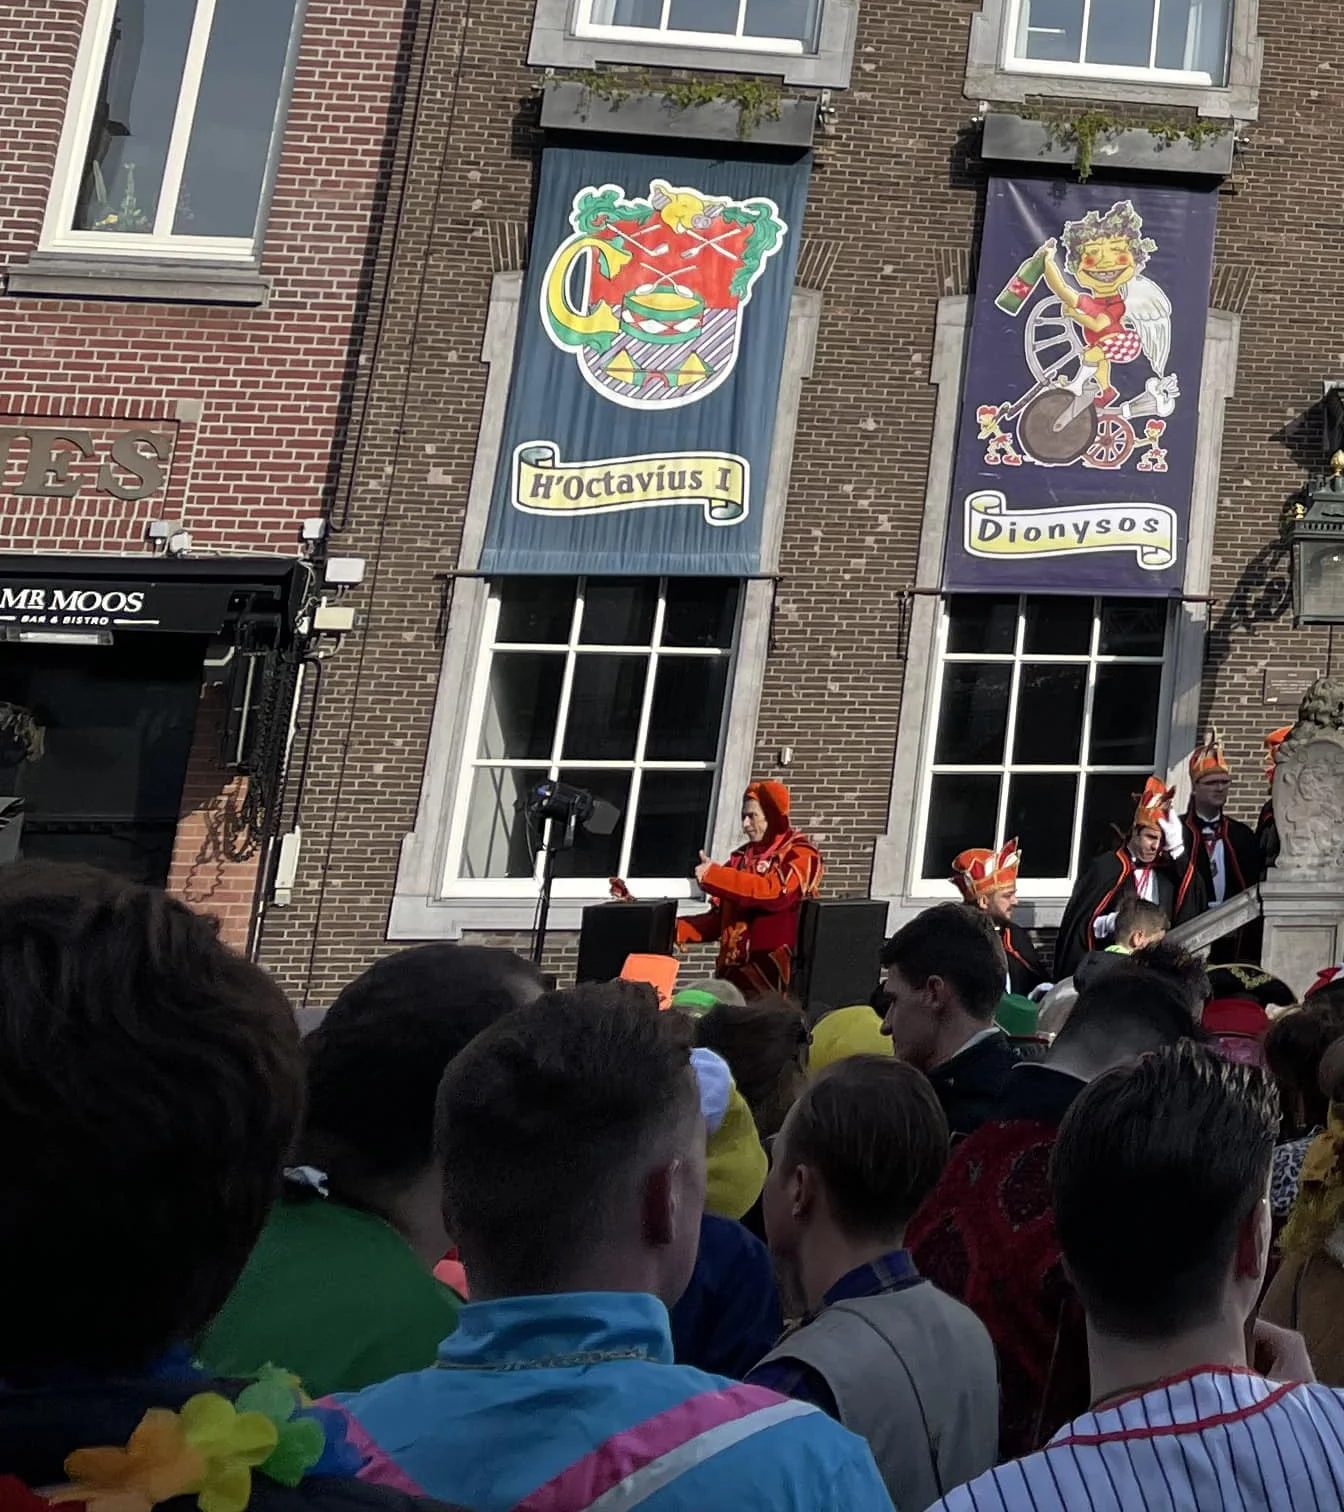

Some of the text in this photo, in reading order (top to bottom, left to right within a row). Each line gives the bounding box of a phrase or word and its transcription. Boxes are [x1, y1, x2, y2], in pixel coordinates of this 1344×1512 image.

[0, 429, 173, 501] ES
[715, 466, 732, 492] I
[977, 517, 1160, 544] Dionysos
[48, 590, 145, 612] MOOS
[21, 615, 46, 624] BAR
[62, 615, 109, 626] BISTRO
